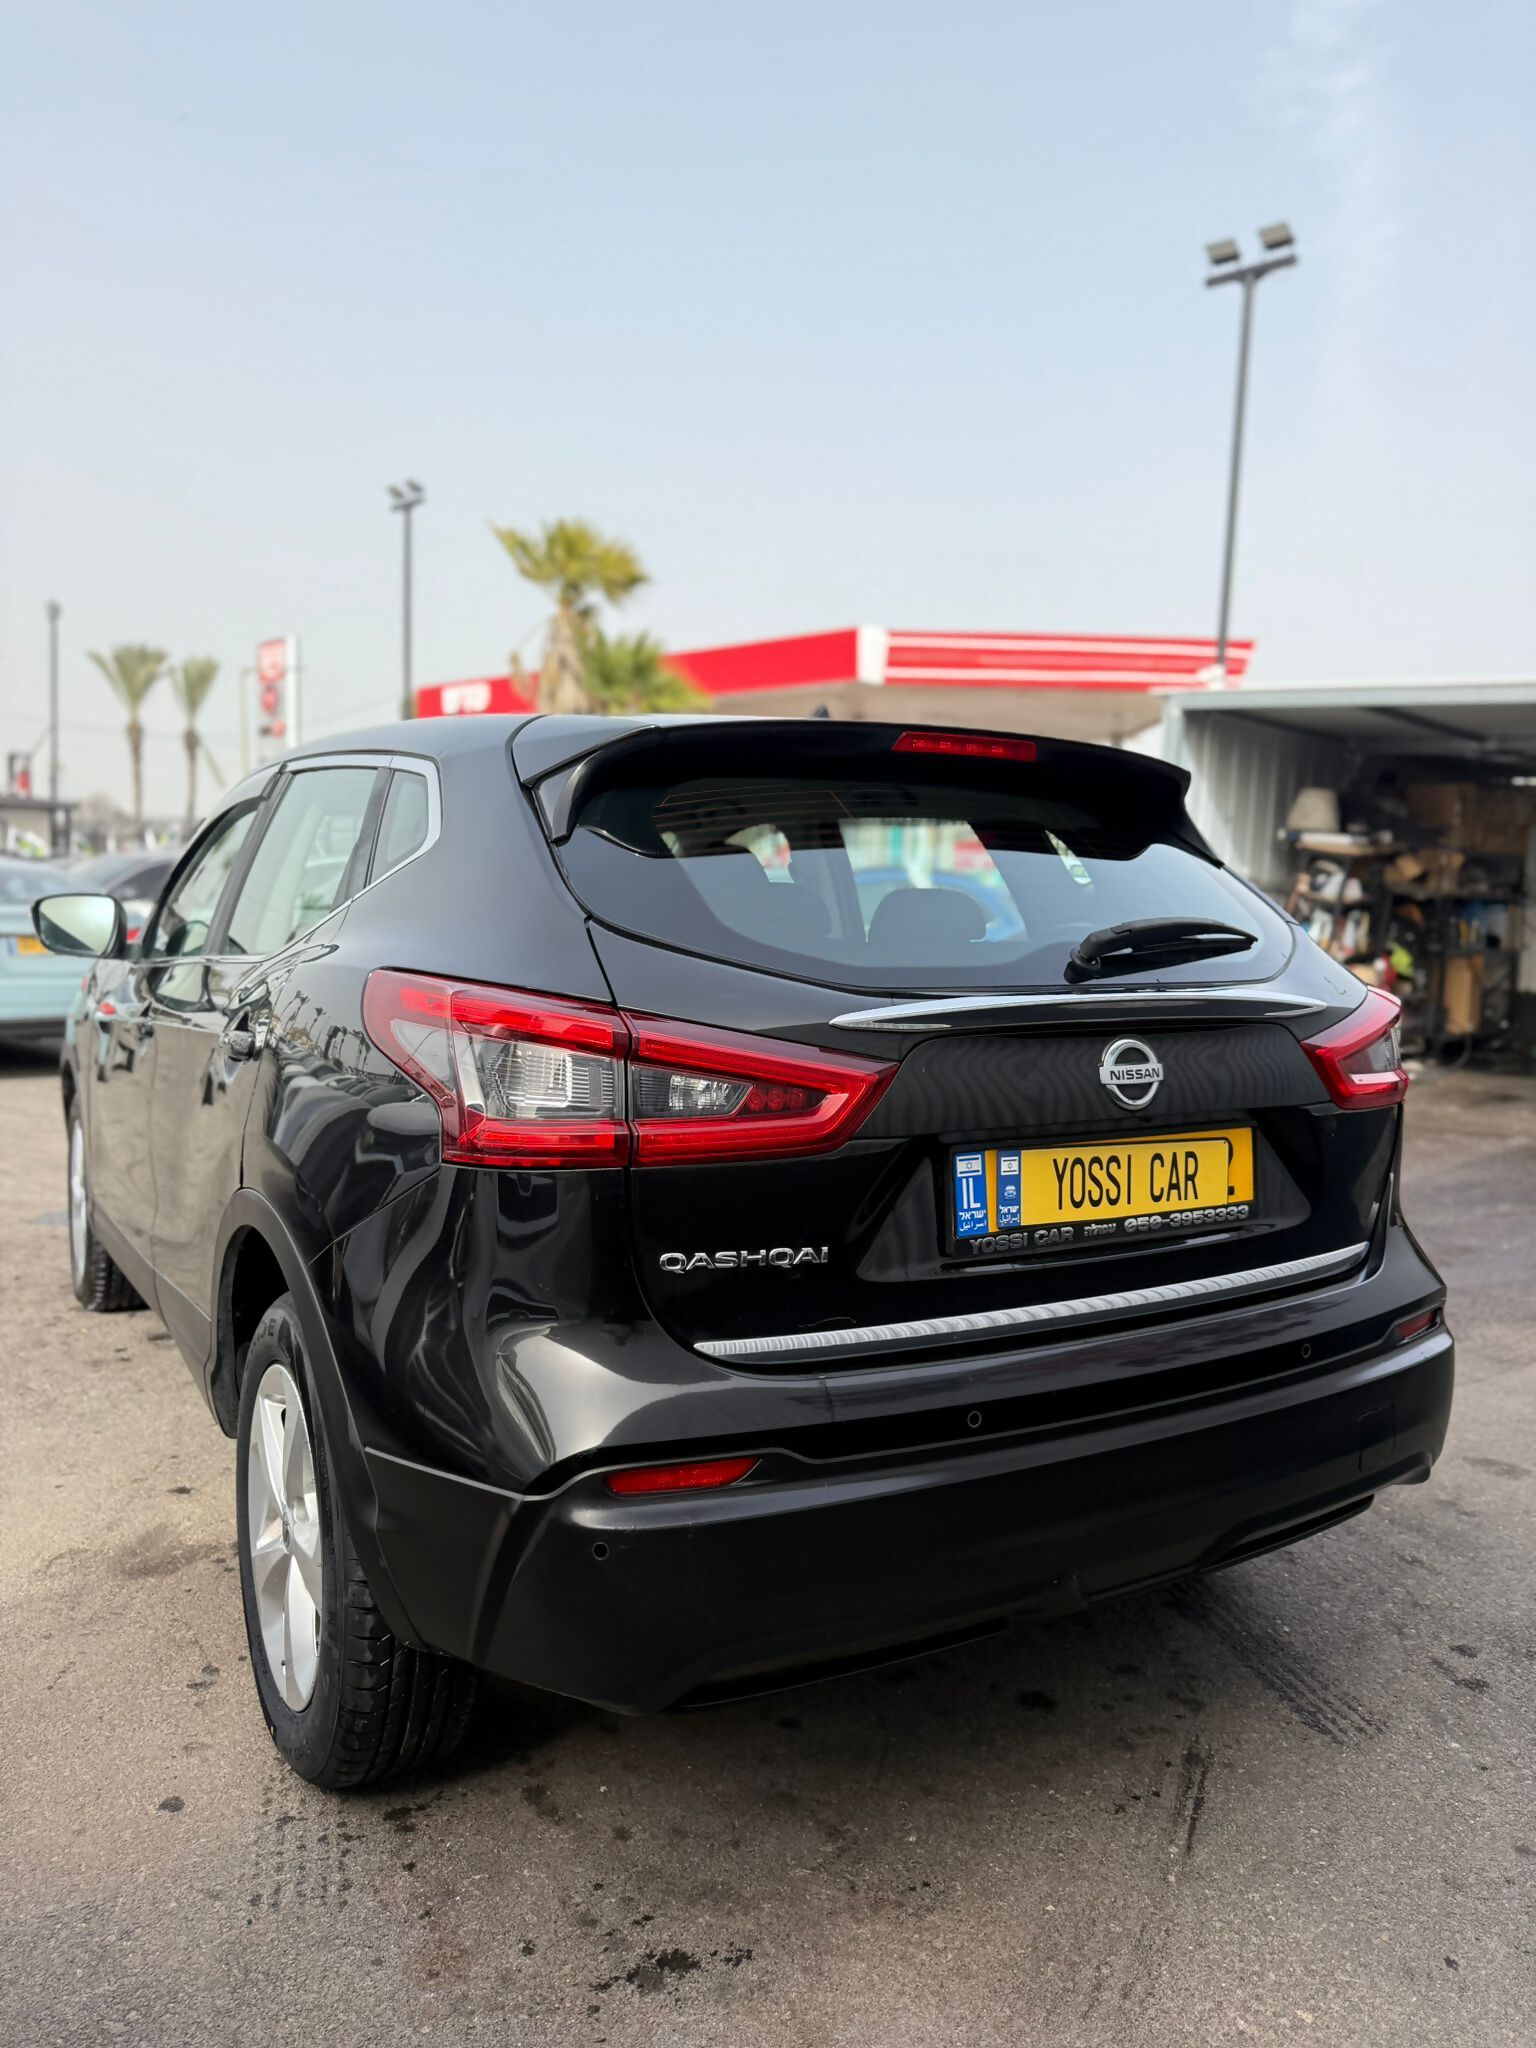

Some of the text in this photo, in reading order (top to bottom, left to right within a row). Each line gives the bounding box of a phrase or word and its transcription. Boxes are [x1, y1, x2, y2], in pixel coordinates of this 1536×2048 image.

[1109, 1067, 1160, 1081] NISSAN
[962, 1177, 981, 1210] IL
[1052, 1154, 1132, 1210] YOSSI
[1150, 1151, 1199, 1203] CAR
[959, 1209, 987, 1221] ישראל
[969, 1232, 1029, 1254] YOSSI
[1034, 1226, 1074, 1246] CAR
[1123, 1204, 1249, 1233] 050-3953333
[659, 1246, 829, 1274] QASHQAI
